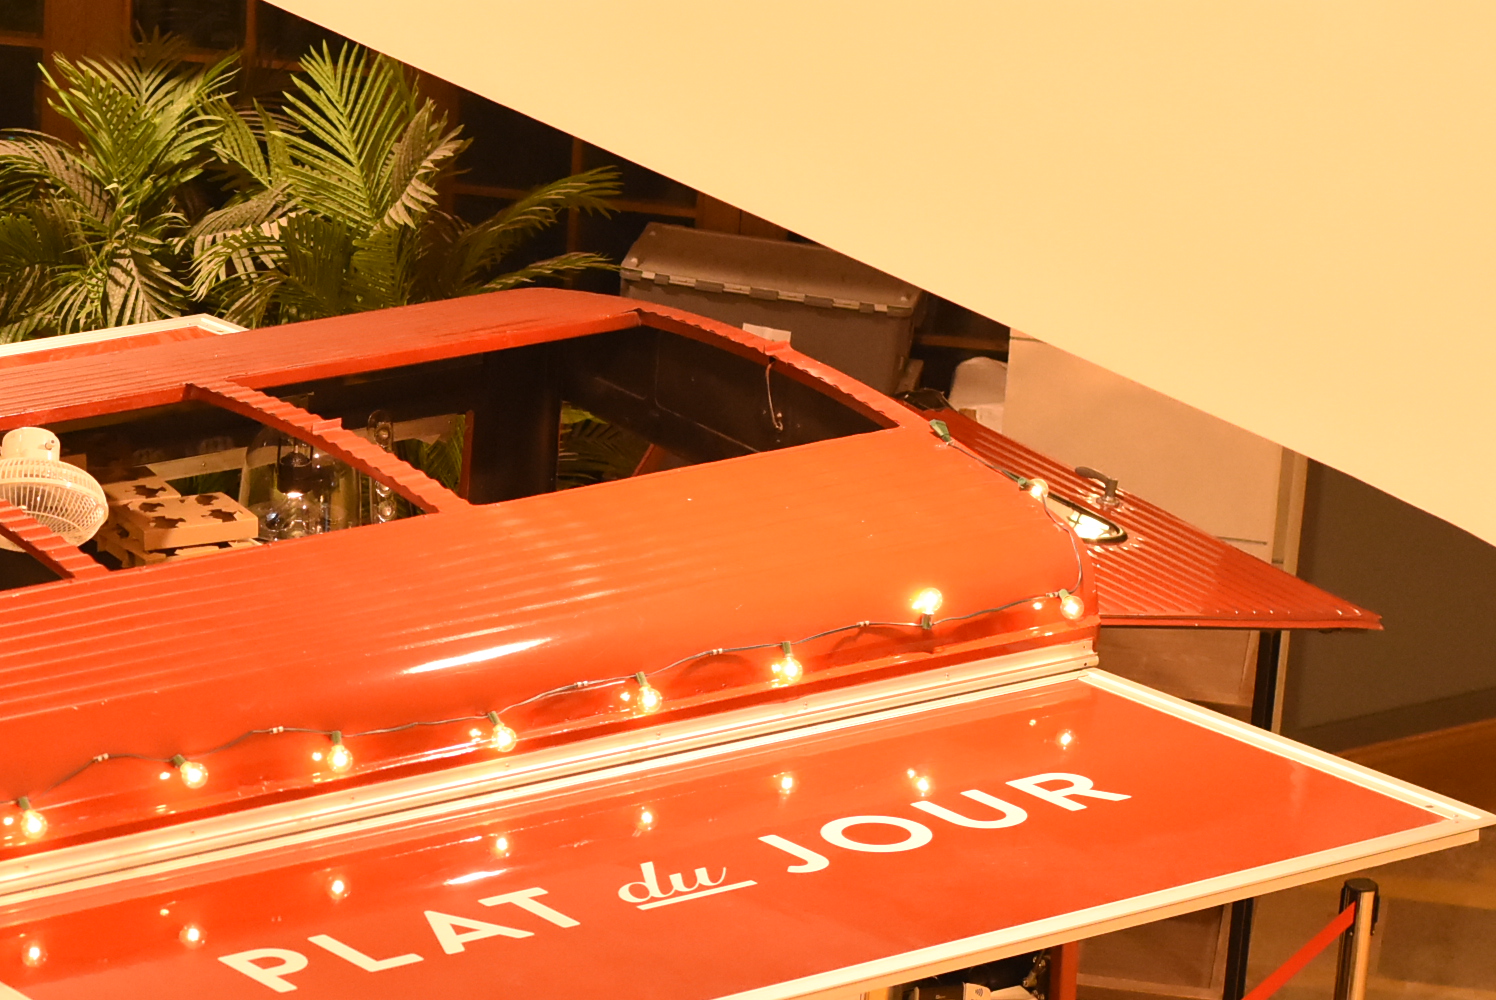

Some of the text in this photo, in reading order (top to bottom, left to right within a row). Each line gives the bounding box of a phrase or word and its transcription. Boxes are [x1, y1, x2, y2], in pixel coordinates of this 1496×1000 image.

[217, 771, 1133, 994] PLAT du JOUR
